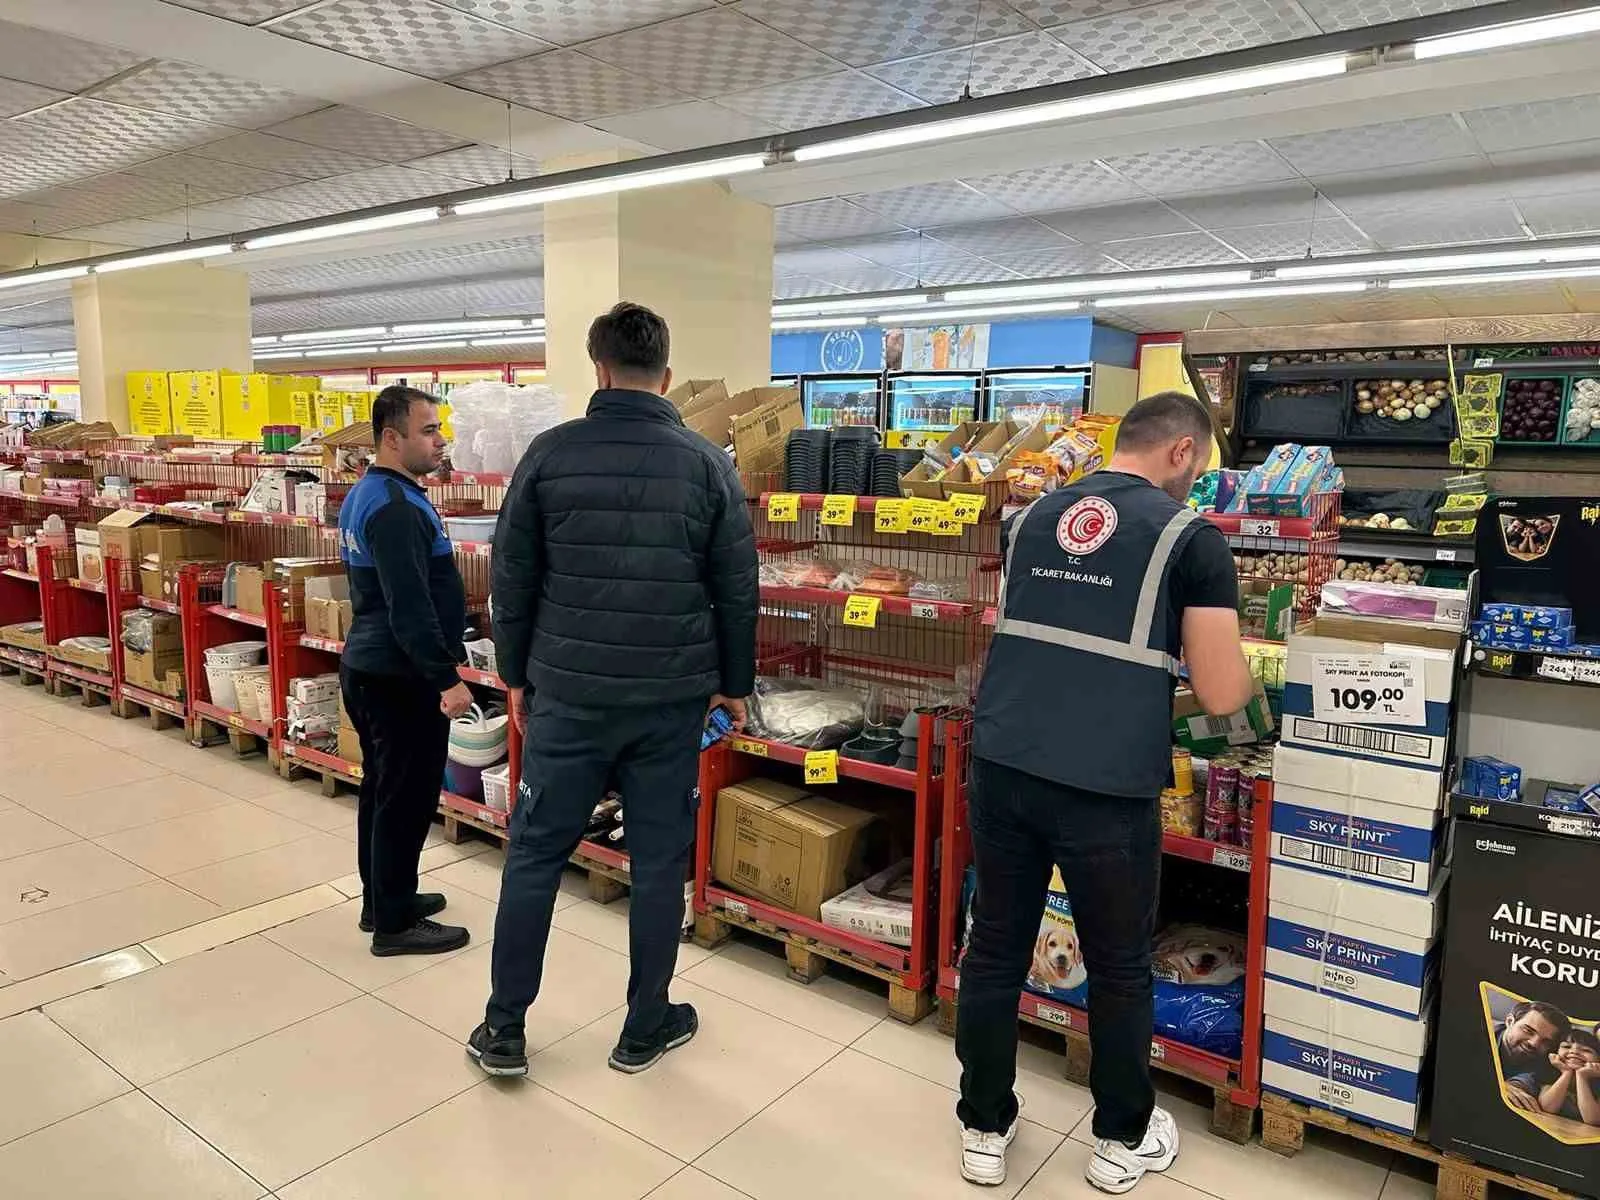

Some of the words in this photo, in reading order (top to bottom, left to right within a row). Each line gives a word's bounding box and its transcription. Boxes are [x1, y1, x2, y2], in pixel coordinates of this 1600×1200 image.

[1256, 525, 1272, 536] 32
[1031, 567, 1064, 579] TİCARET
[1383, 704, 1395, 713] TL
[1308, 820, 1337, 834] SKY
[1340, 825, 1386, 844] PRINT
[1046, 893, 1069, 910] REE
[1489, 926, 1553, 954] İHTİYAÇ
[1305, 937, 1333, 953] SKY
[1337, 946, 1381, 965] PRINT
[1302, 1051, 1329, 1068] SKY
[1333, 1061, 1377, 1081] PRINT
